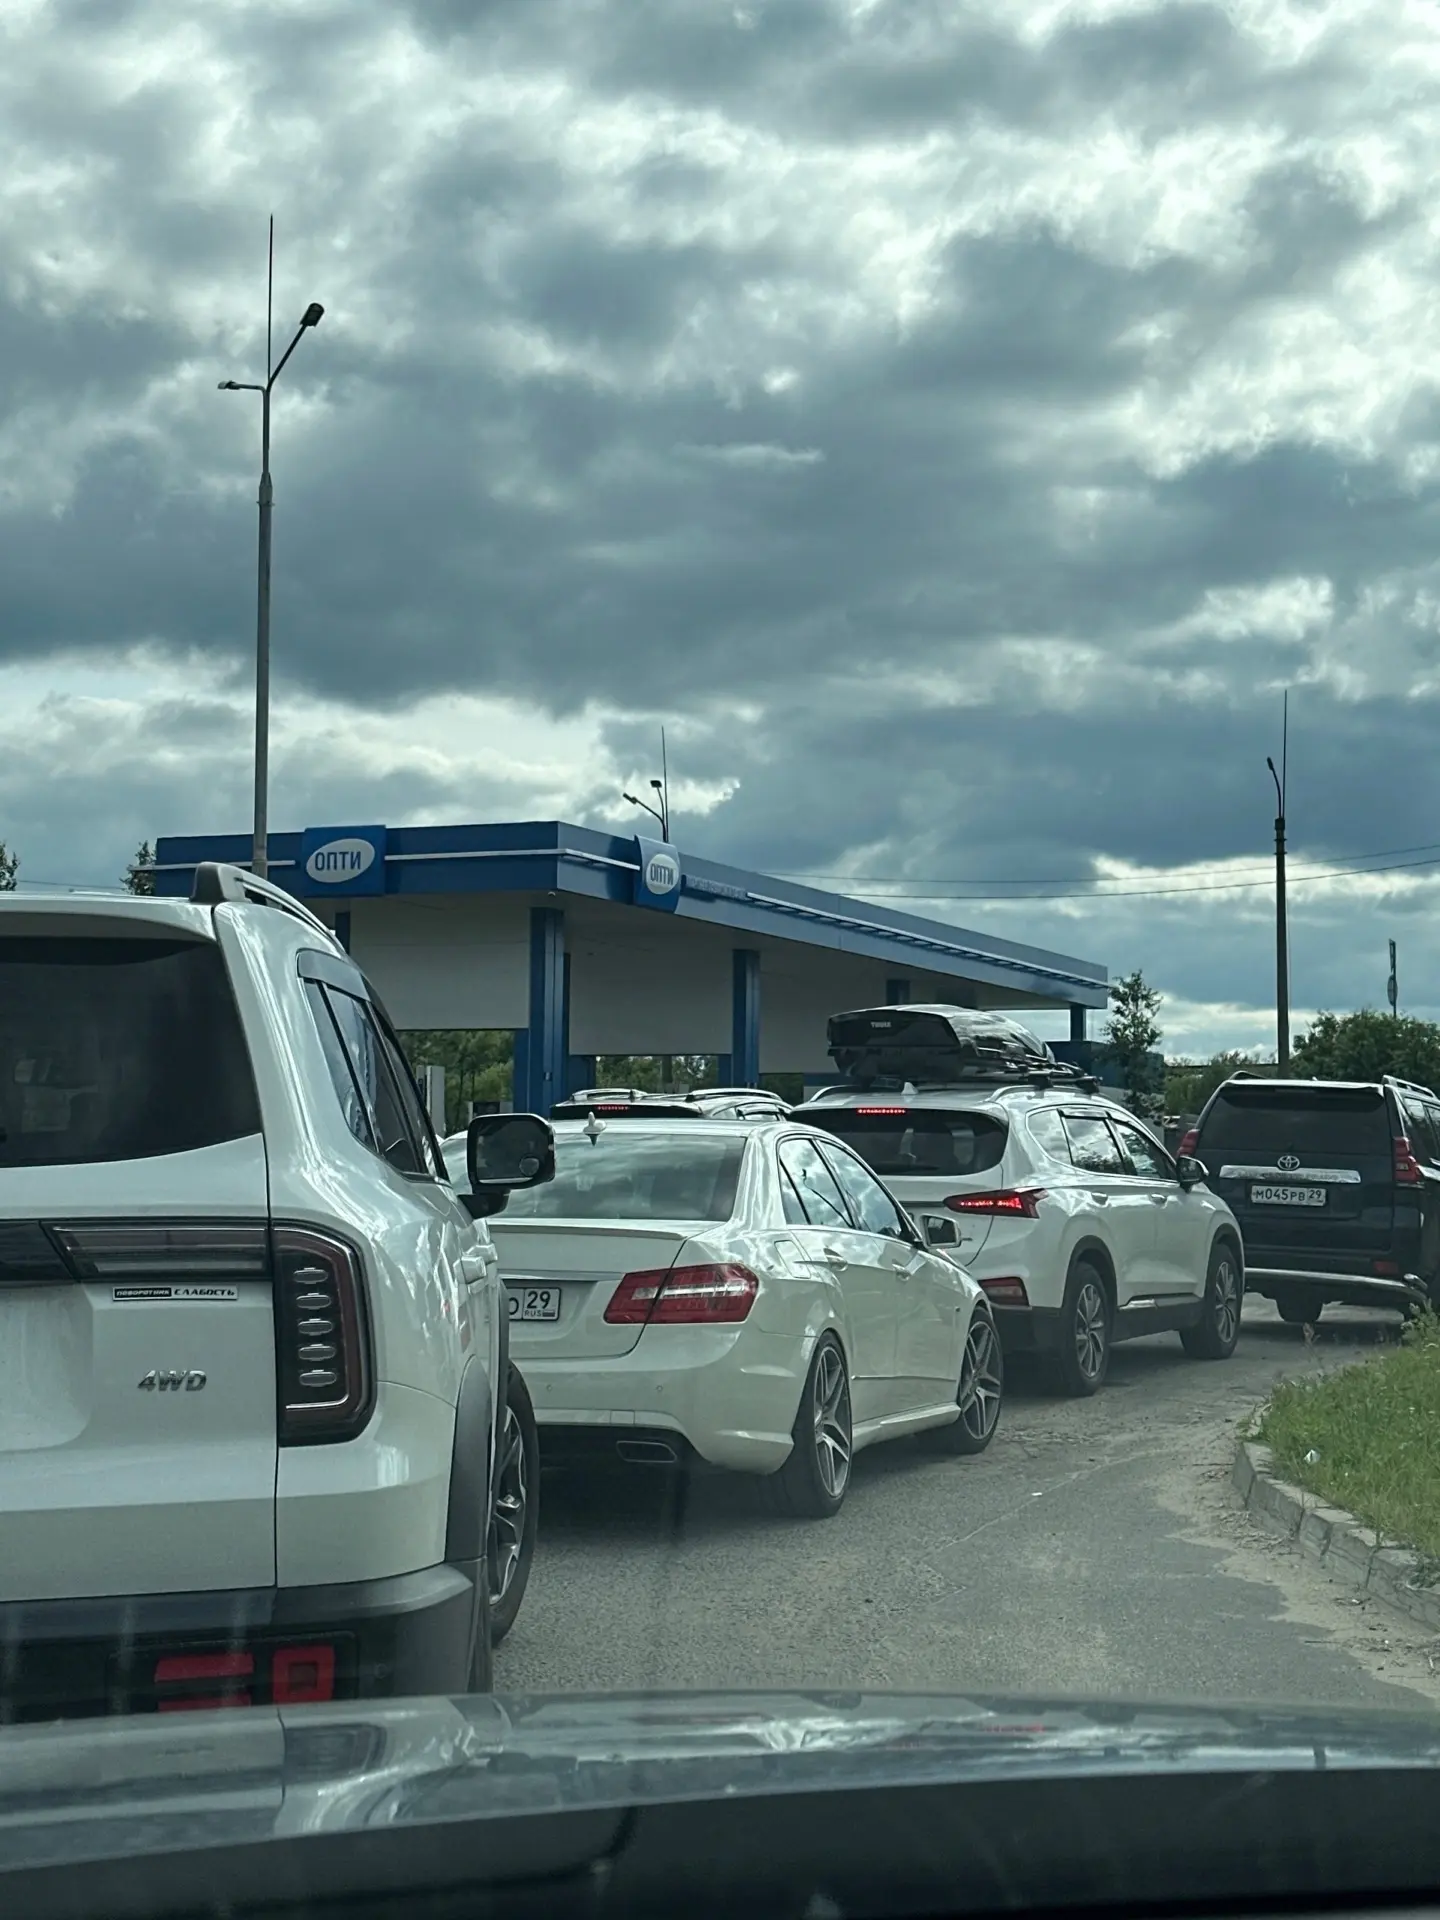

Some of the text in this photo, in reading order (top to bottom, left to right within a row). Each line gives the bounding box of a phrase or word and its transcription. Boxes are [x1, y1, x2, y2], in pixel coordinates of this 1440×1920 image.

[314, 851, 362, 871] ОПТИ
[650, 863, 674, 886] ОПТИ
[1309, 1189, 1322, 1199] 29
[174, 1288, 235, 1296] СЛАБОСТЬ
[526, 1290, 551, 1309] 29
[137, 1370, 207, 1392] 4WD
